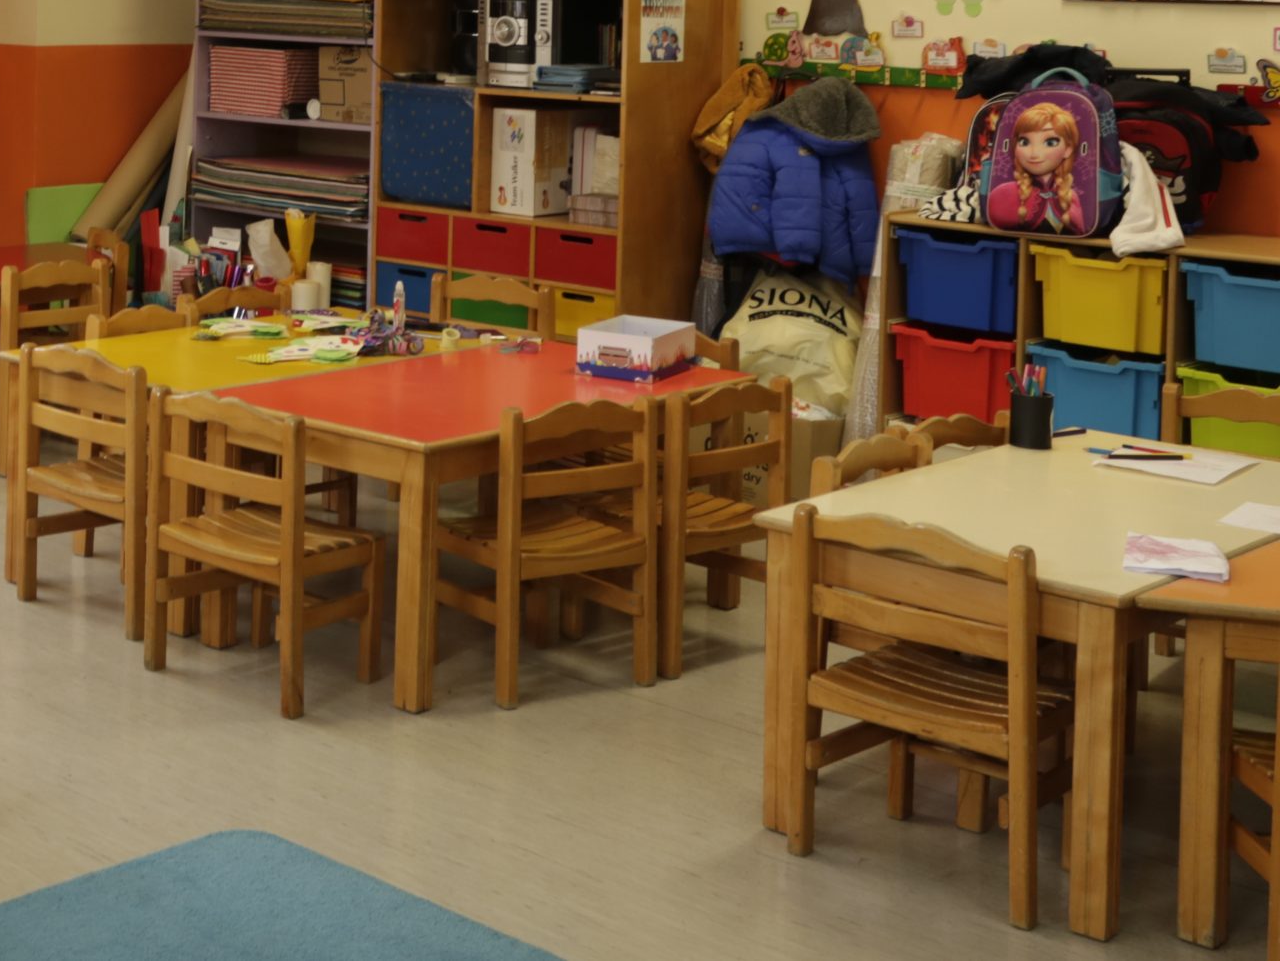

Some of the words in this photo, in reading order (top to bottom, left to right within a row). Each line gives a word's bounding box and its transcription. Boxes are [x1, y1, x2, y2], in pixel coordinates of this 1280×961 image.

[511, 155, 519, 184] Walker
[511, 186, 519, 207] Team
[748, 287, 847, 328] SIONA
[743, 471, 763, 485] dry
